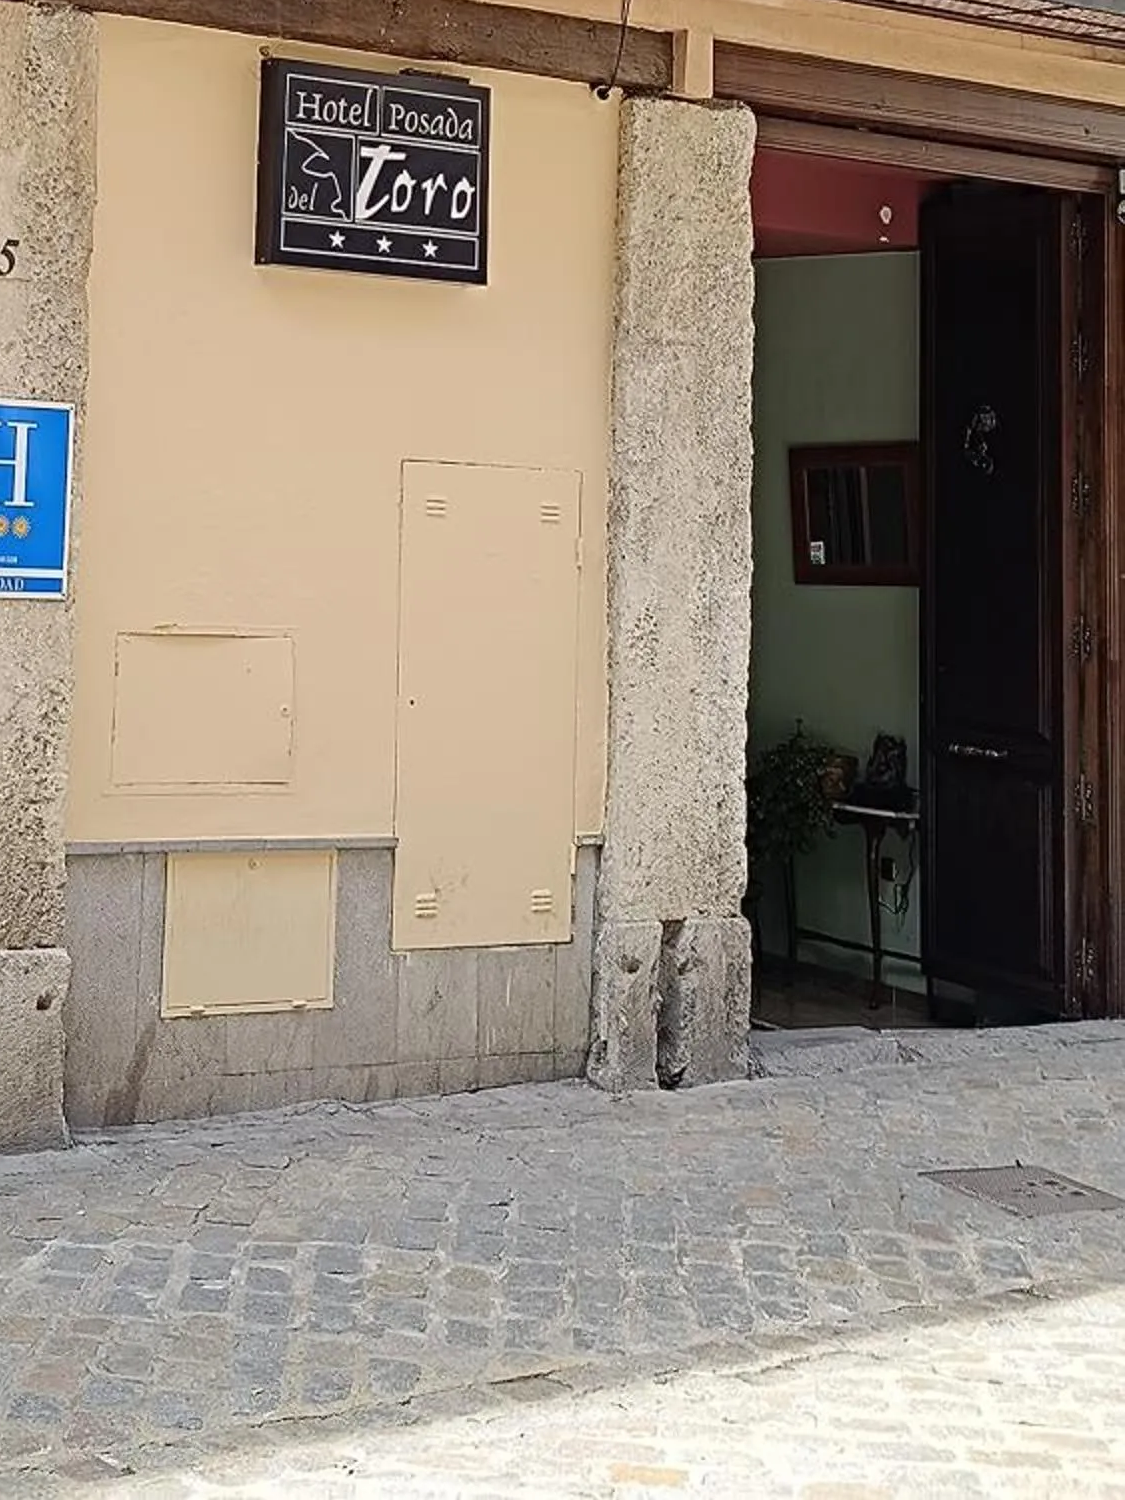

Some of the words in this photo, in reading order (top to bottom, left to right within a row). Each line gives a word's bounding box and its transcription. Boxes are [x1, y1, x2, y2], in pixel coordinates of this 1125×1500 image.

[295, 87, 374, 128] Hotel
[388, 103, 474, 142] Posada
[288, 182, 319, 211] del
[355, 144, 476, 220] Toro
